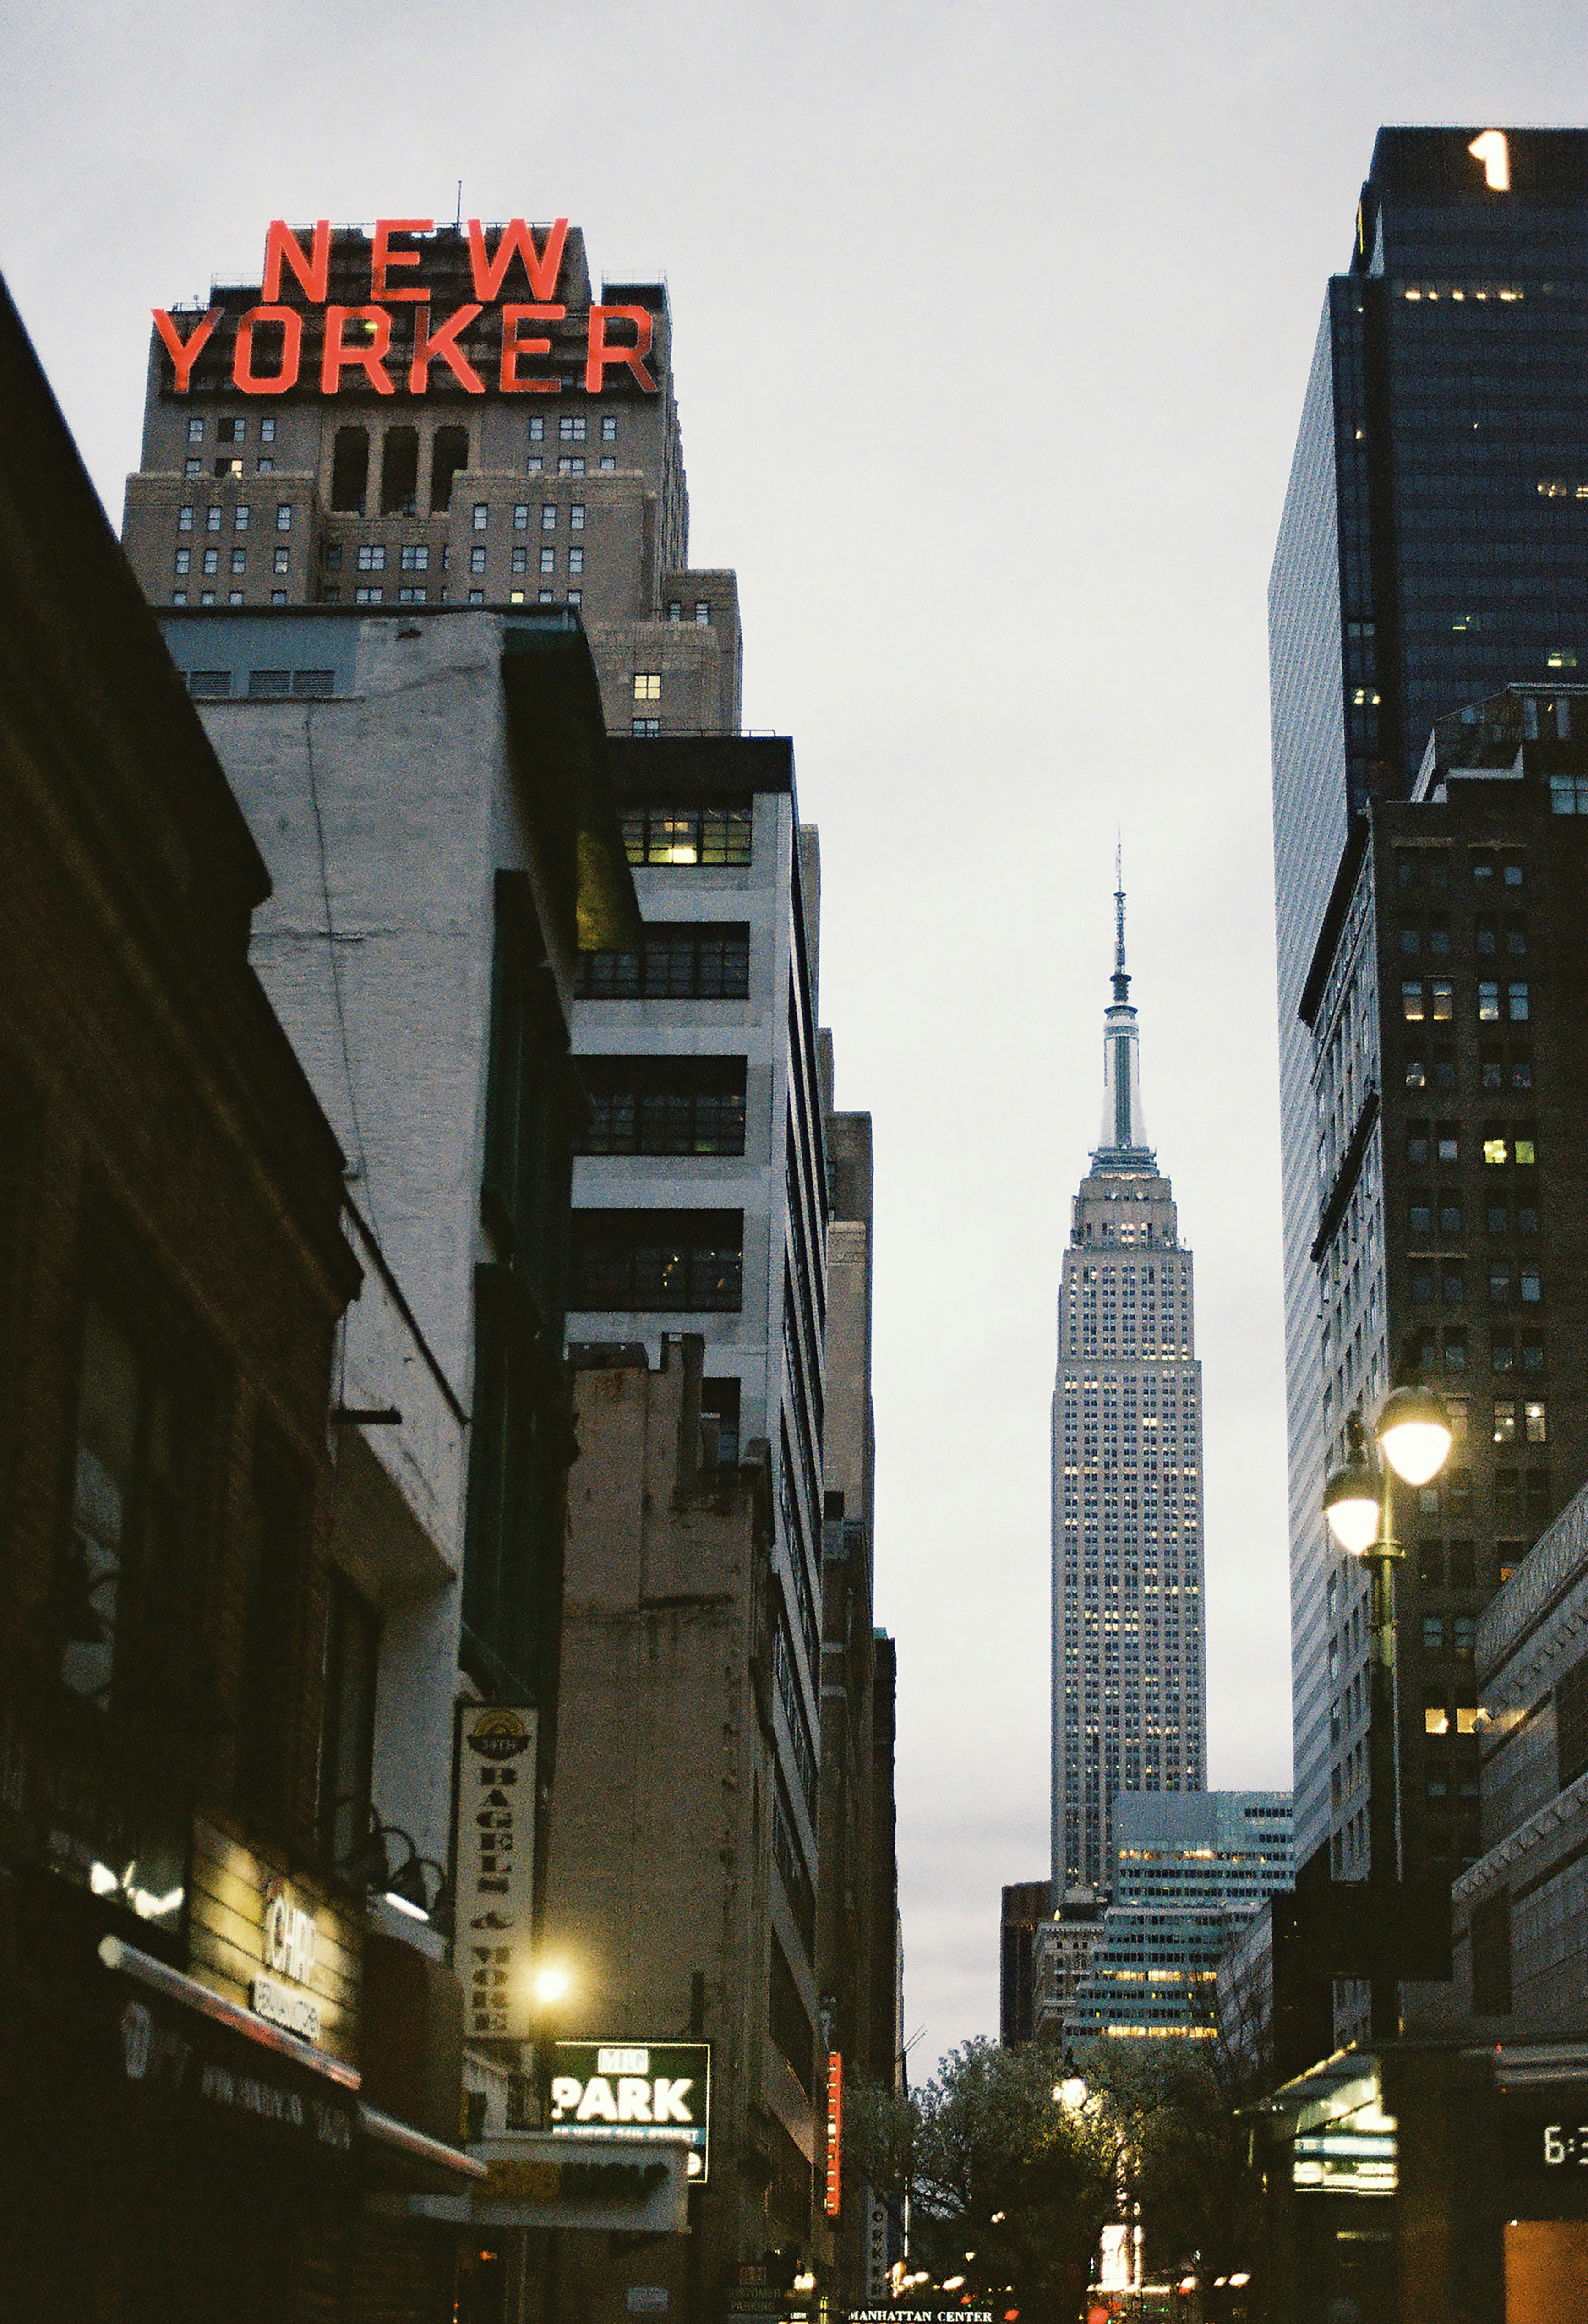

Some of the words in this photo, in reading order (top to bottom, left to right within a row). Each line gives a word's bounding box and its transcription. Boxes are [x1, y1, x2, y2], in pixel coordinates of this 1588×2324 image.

[1468, 130, 1511, 191] 1
[262, 218, 568, 303] NEW
[151, 304, 659, 394] YORKER
[552, 2077, 693, 2122] PARK
[847, 2310, 932, 2322] MANHATTAN
[937, 2311, 993, 2323] CENTER
